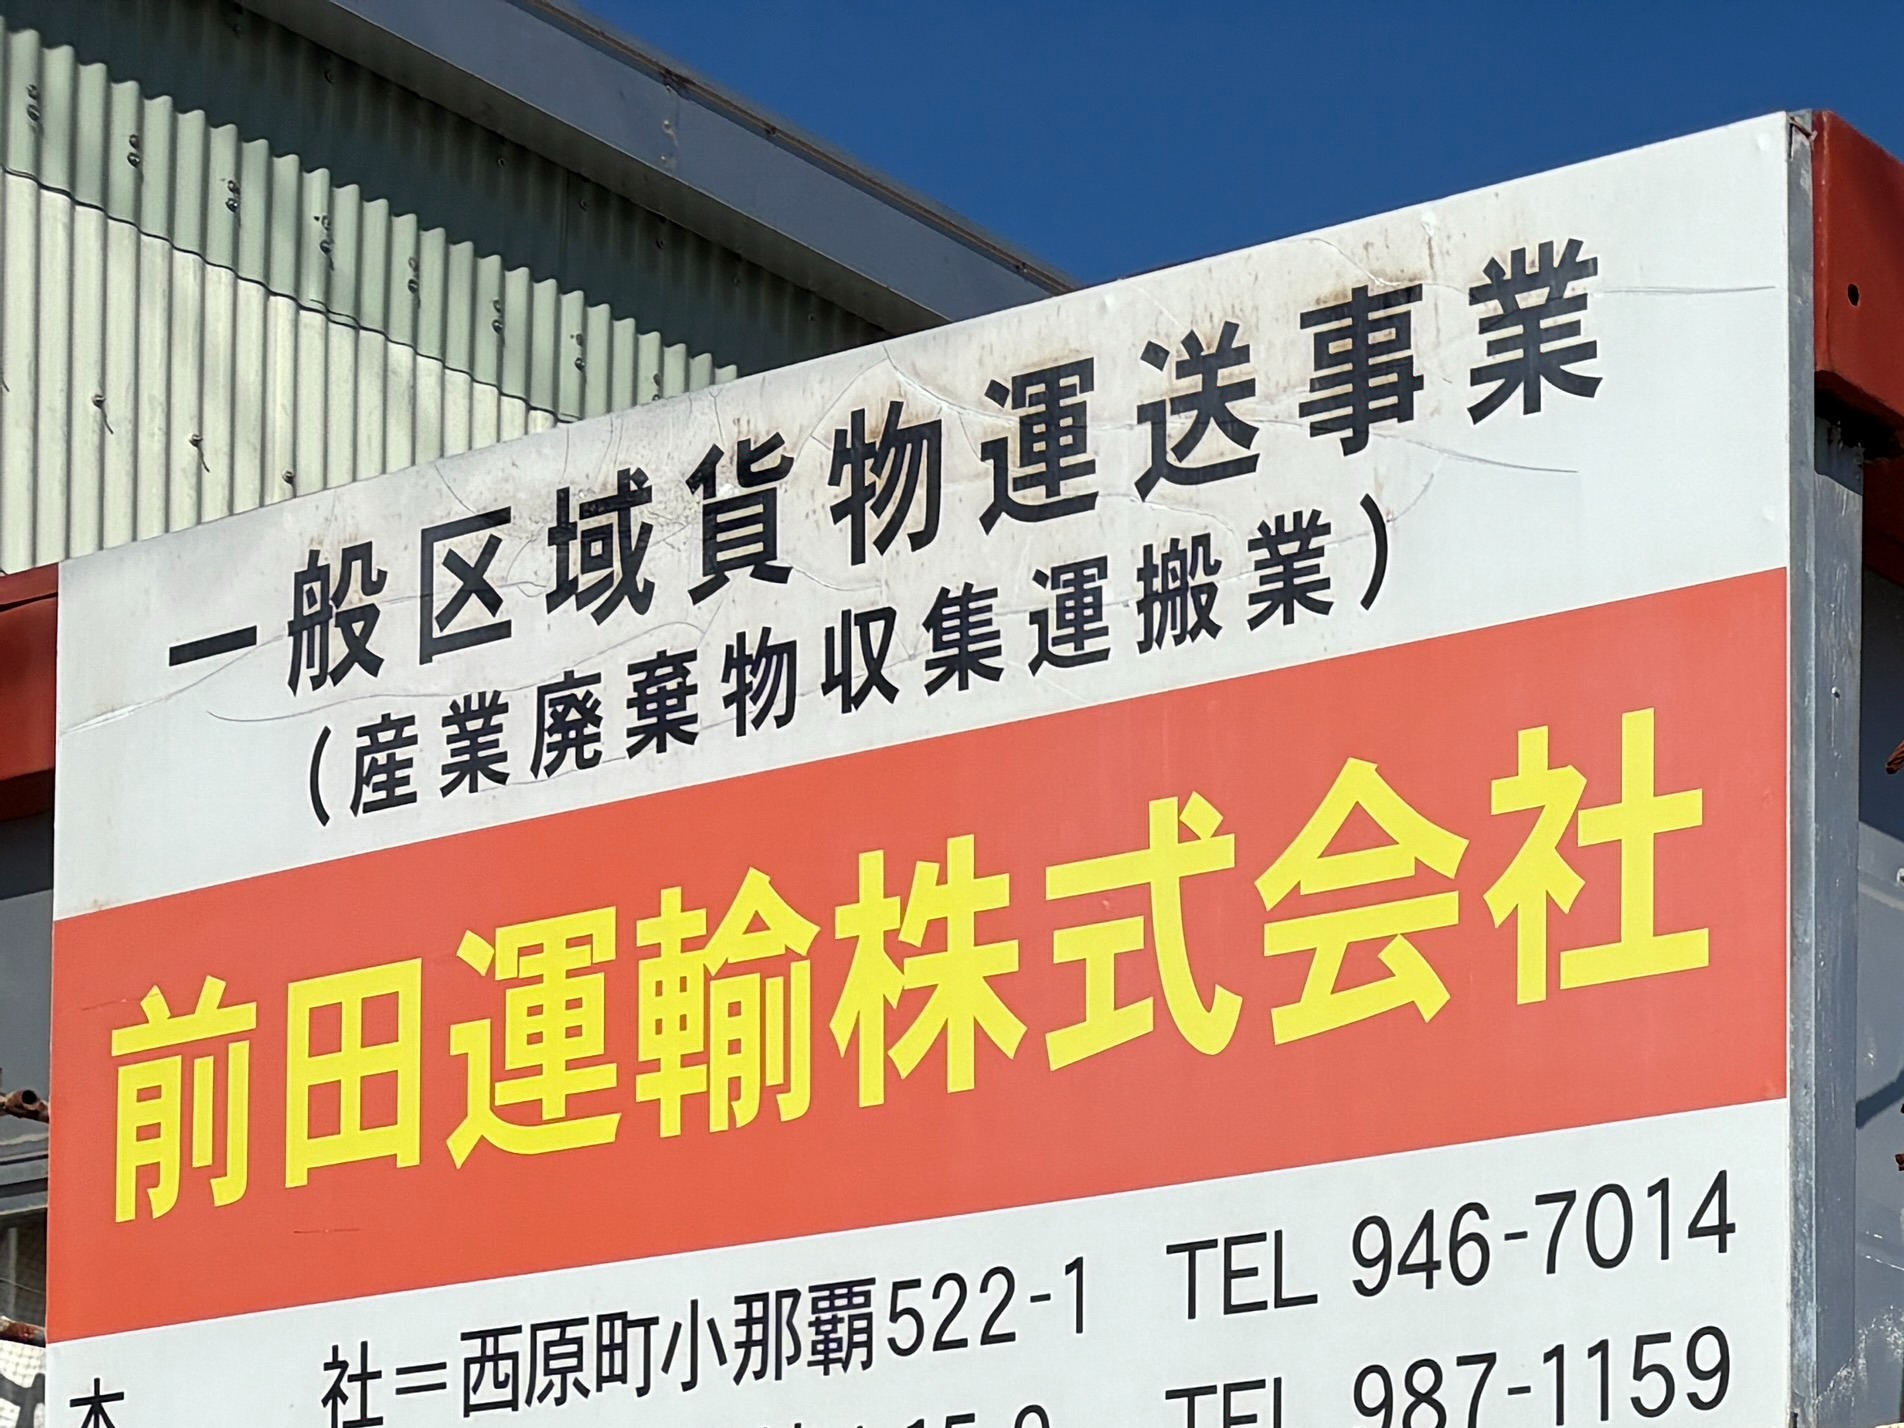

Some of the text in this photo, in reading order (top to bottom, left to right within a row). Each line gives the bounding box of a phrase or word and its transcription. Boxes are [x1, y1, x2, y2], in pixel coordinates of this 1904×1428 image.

[168, 237, 1603, 692] 一般区域貨物運送事業
[308, 492, 1389, 826] （産業廃棄物収集運搬業）
[111, 706, 1710, 1222] 前田運輸株式会社
[1166, 1229, 1319, 1321] TEL
[1351, 1169, 1736, 1298] 946-7014
